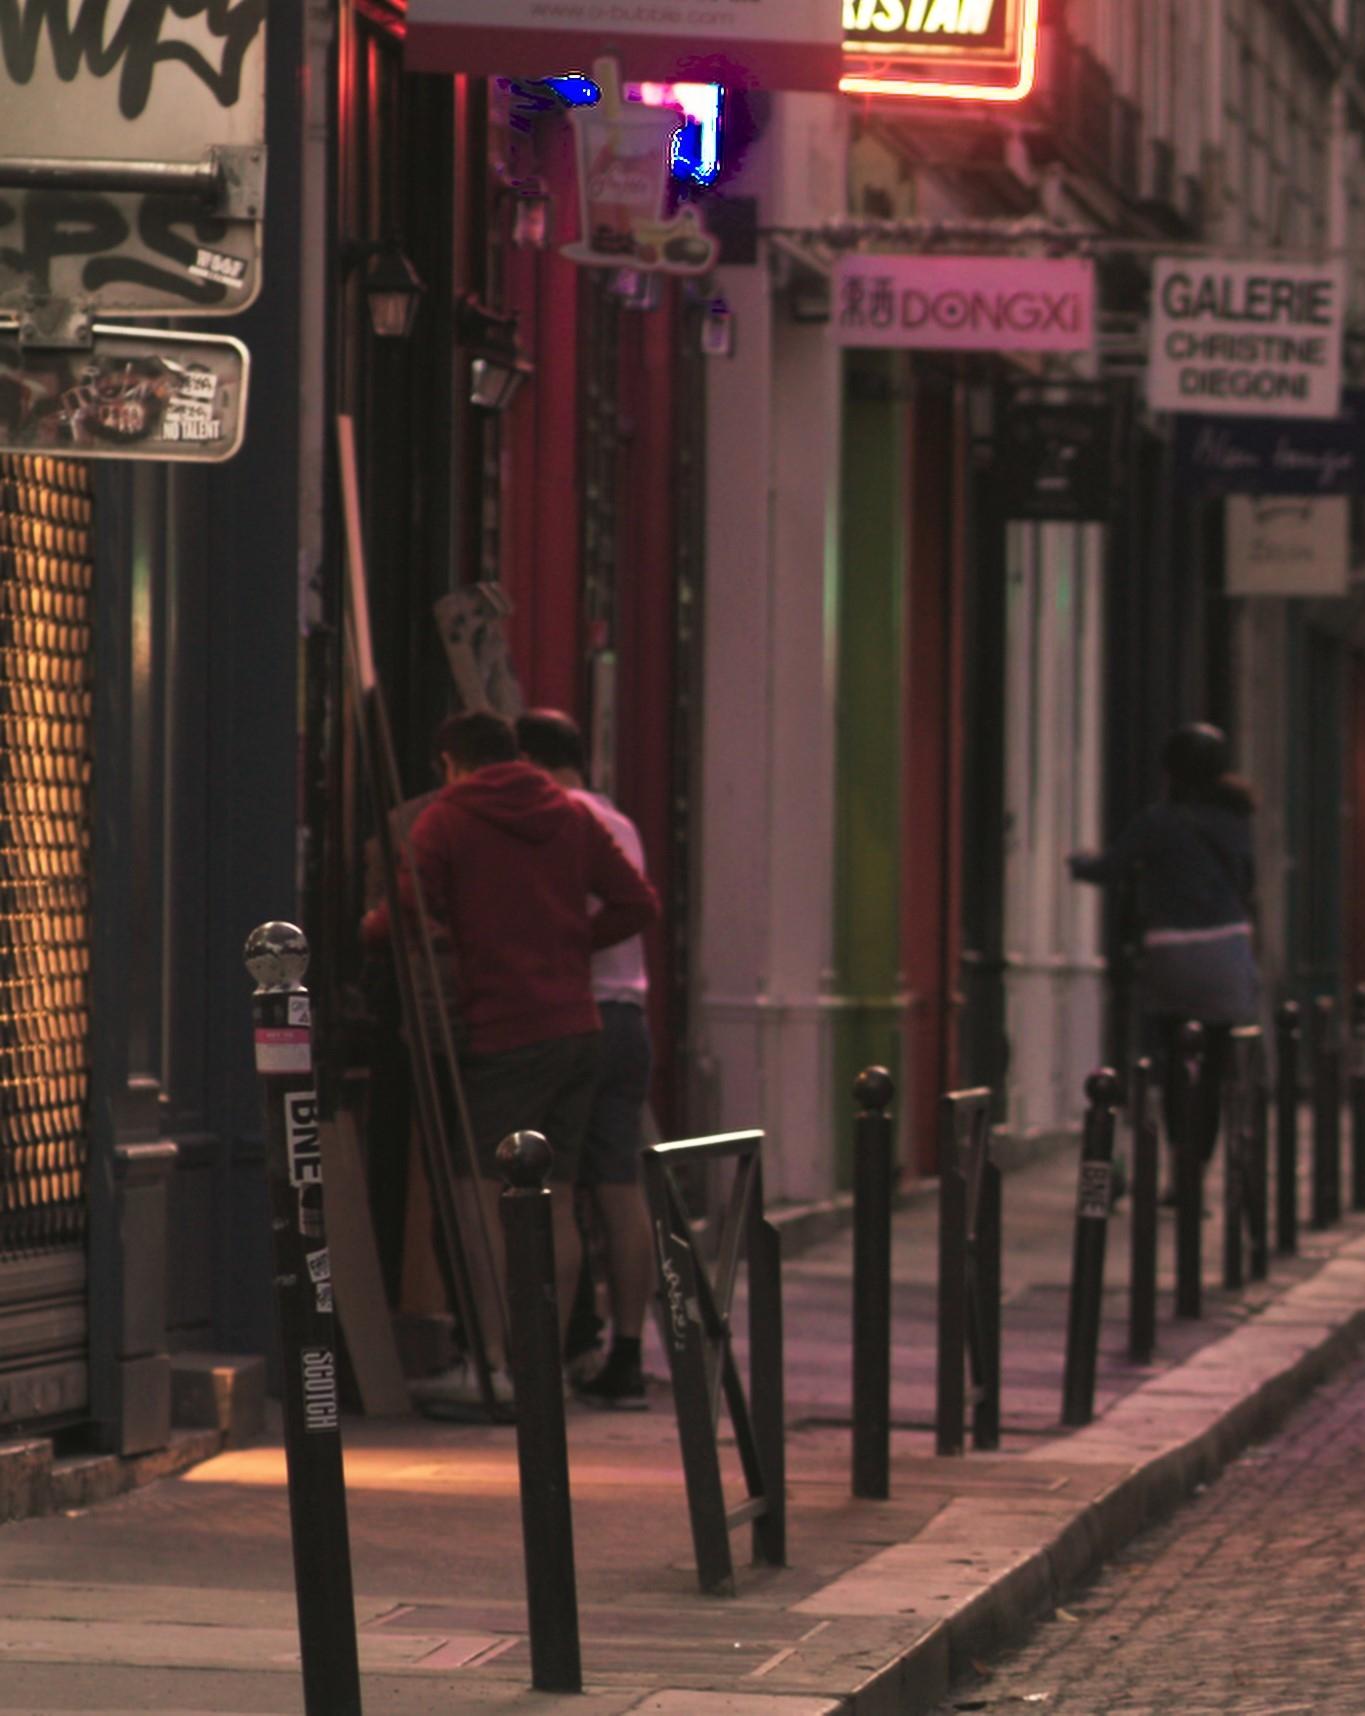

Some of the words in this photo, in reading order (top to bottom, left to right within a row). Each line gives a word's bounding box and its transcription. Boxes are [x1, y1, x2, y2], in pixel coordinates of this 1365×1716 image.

[1161, 272, 1334, 325] GALERIE
[1165, 331, 1327, 365] CHRISTINE
[1179, 367, 1309, 401] DIEGONI
[181, 419, 221, 440] TALENT
[290, 1100, 321, 1181] BNE
[302, 1350, 338, 1430] SCOTCH
